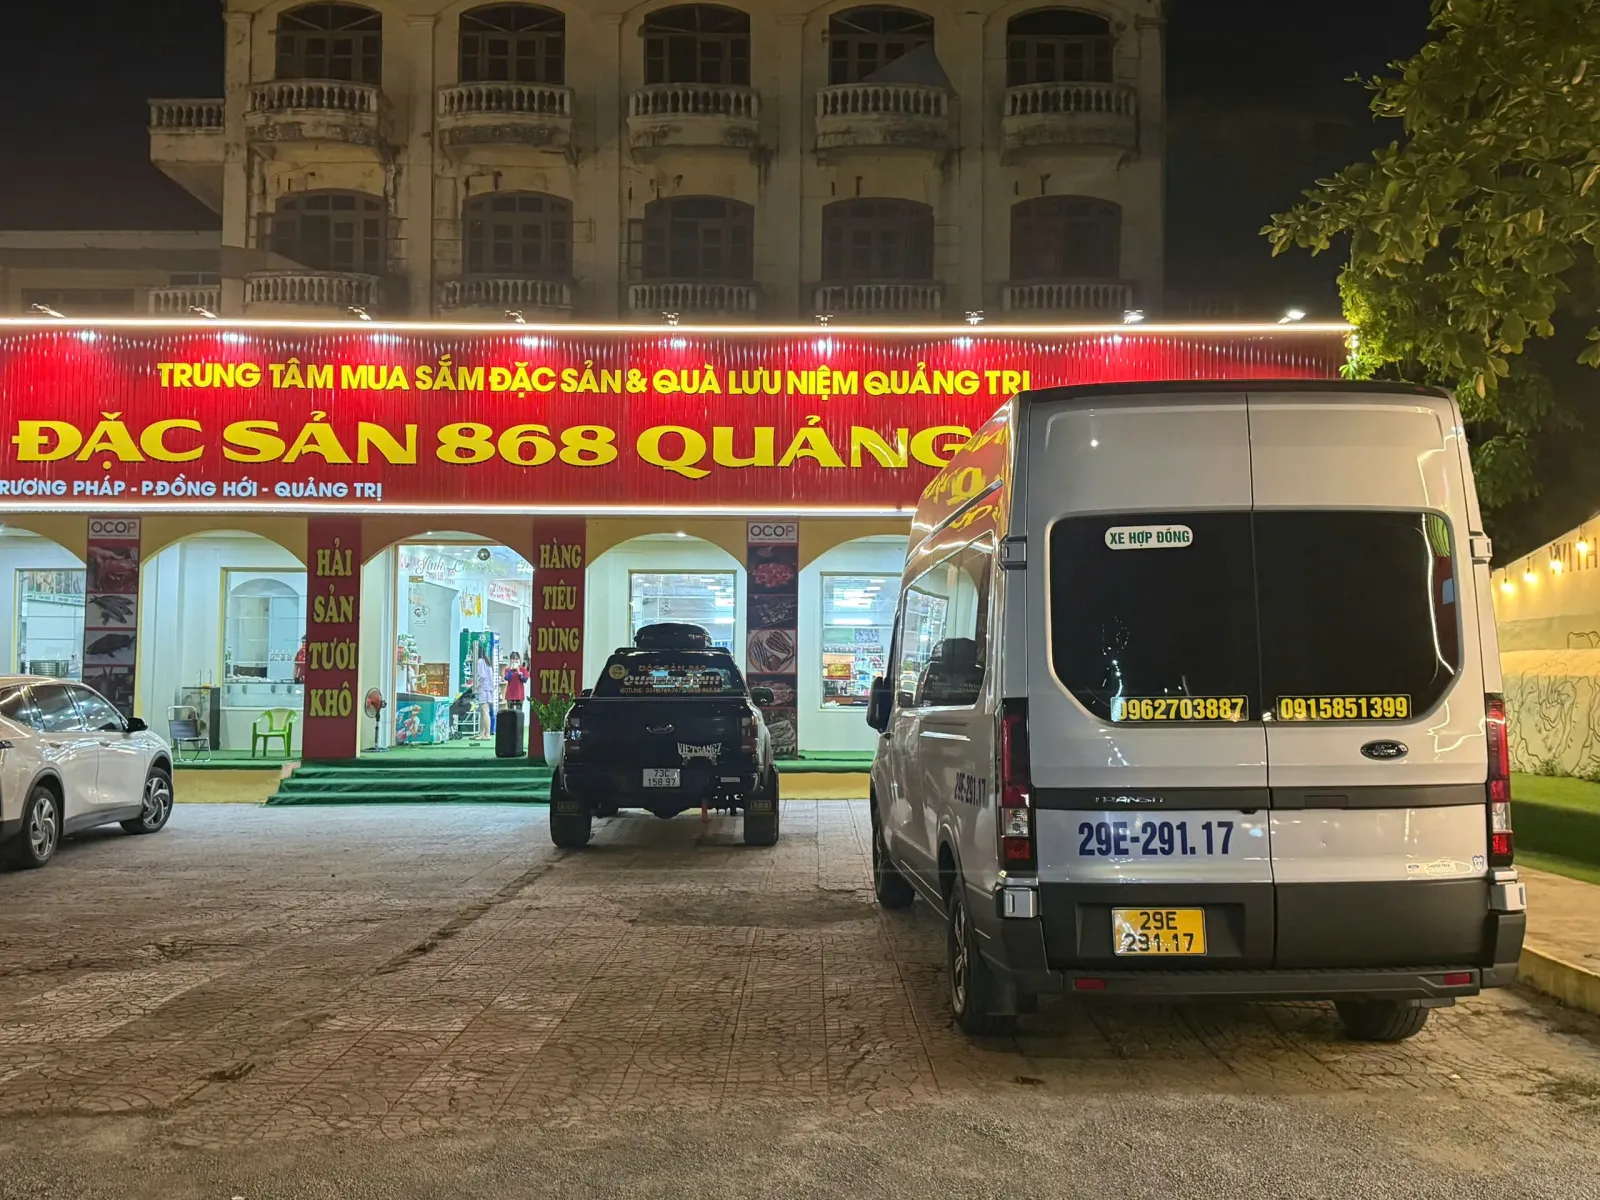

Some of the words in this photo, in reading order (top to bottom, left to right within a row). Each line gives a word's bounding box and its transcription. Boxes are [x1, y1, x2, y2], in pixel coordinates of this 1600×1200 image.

[157, 363, 261, 388] TRUNG
[269, 357, 333, 389] TÂM
[341, 365, 409, 390] MUA
[416, 354, 484, 391] SẮM
[489, 361, 556, 398] ĐẶC
[561, 359, 620, 393] SẢN
[626, 368, 648, 393] &
[653, 363, 721, 395] QUÀ
[729, 366, 781, 395] LƯU
[787, 364, 858, 400] NIỆM
[864, 362, 980, 396] QUẢNG
[12, 411, 205, 470] ĐẶC
[222, 410, 418, 465] SẢN
[436, 422, 618, 467] 868
[636, 415, 974, 479] QUẢNG
[73, 475, 126, 496] PHÁP
[141, 473, 216, 497] P.ĐỒNG
[223, 476, 257, 497] HỚI
[274, 476, 349, 498] QUẢNG
[354, 482, 382, 501] TRỊ
[91, 521, 137, 533] OCOP
[750, 525, 795, 537] OCOP
[1109, 532, 1125, 544] XE
[1128, 530, 1152, 547] HỢP
[1156, 527, 1190, 543] ĐỒNG
[316, 537, 352, 576] HẢI
[540, 537, 582, 569] HÀNG
[313, 584, 354, 623] SẢN
[543, 579, 577, 610] TIÊU
[537, 621, 580, 652] DÙNG
[309, 637, 356, 670] TƯƠI
[540, 663, 576, 694] THÁI
[309, 681, 352, 717] KHÔ
[1281, 697, 1408, 719] 0915851399
[647, 777, 676, 786] 158.97
[653, 769, 670, 777] 73C
[1139, 911, 1178, 930] 29E
[1123, 933, 1194, 952] 291.17
